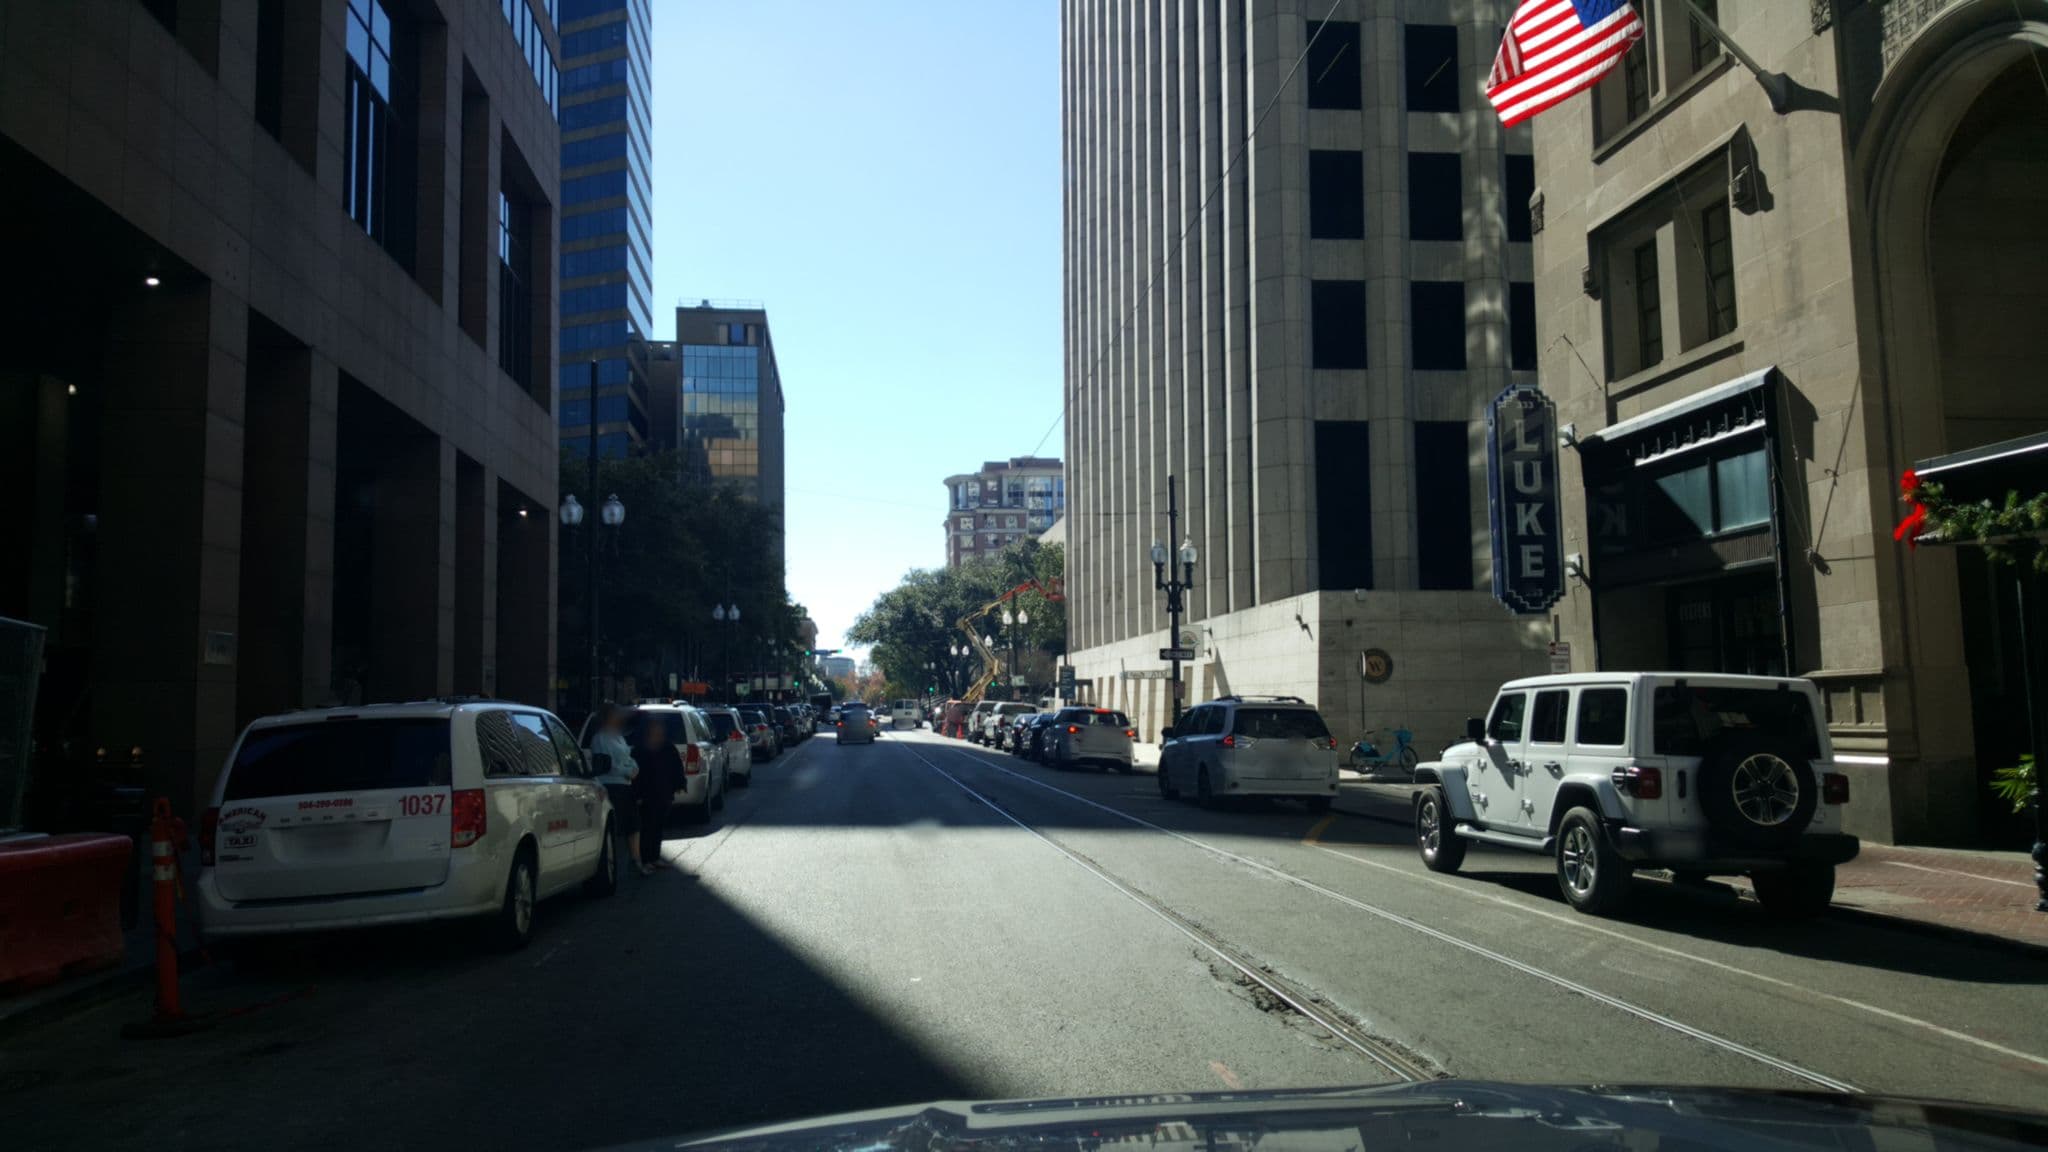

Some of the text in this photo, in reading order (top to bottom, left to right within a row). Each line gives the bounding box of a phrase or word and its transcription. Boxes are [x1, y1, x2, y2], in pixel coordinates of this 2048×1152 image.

[1514, 419, 1546, 579] LUKE
[398, 794, 446, 816] 1037
[217, 806, 266, 825] AMERICAN
[226, 834, 254, 846] TAXI
